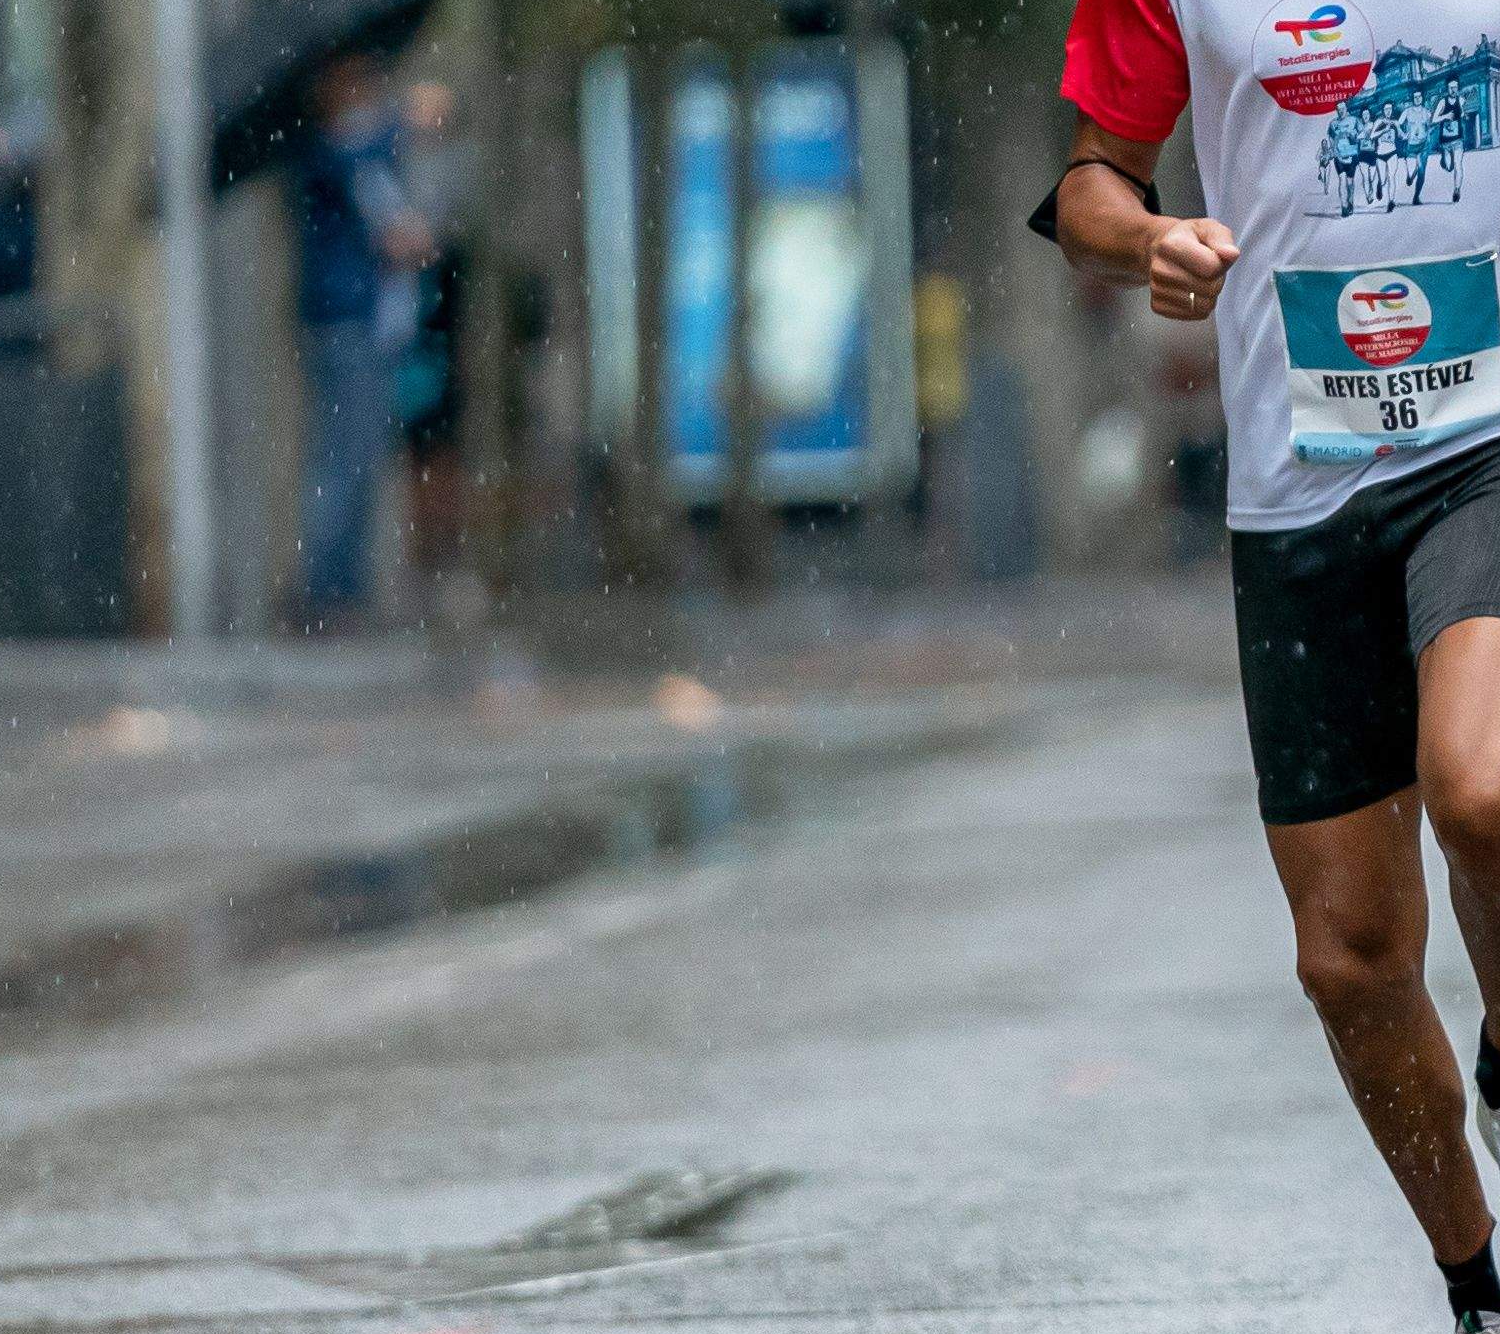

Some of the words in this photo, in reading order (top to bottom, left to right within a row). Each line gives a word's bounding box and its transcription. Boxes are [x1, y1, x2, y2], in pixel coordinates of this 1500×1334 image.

[1278, 48, 1351, 67] TotalEnergies
[1371, 331, 1399, 341] MILLA
[1323, 374, 1381, 399] REYES
[1387, 359, 1475, 397] ESTÉVEZ
[1379, 397, 1419, 431] 36
[1313, 446, 1362, 458] MADRID
